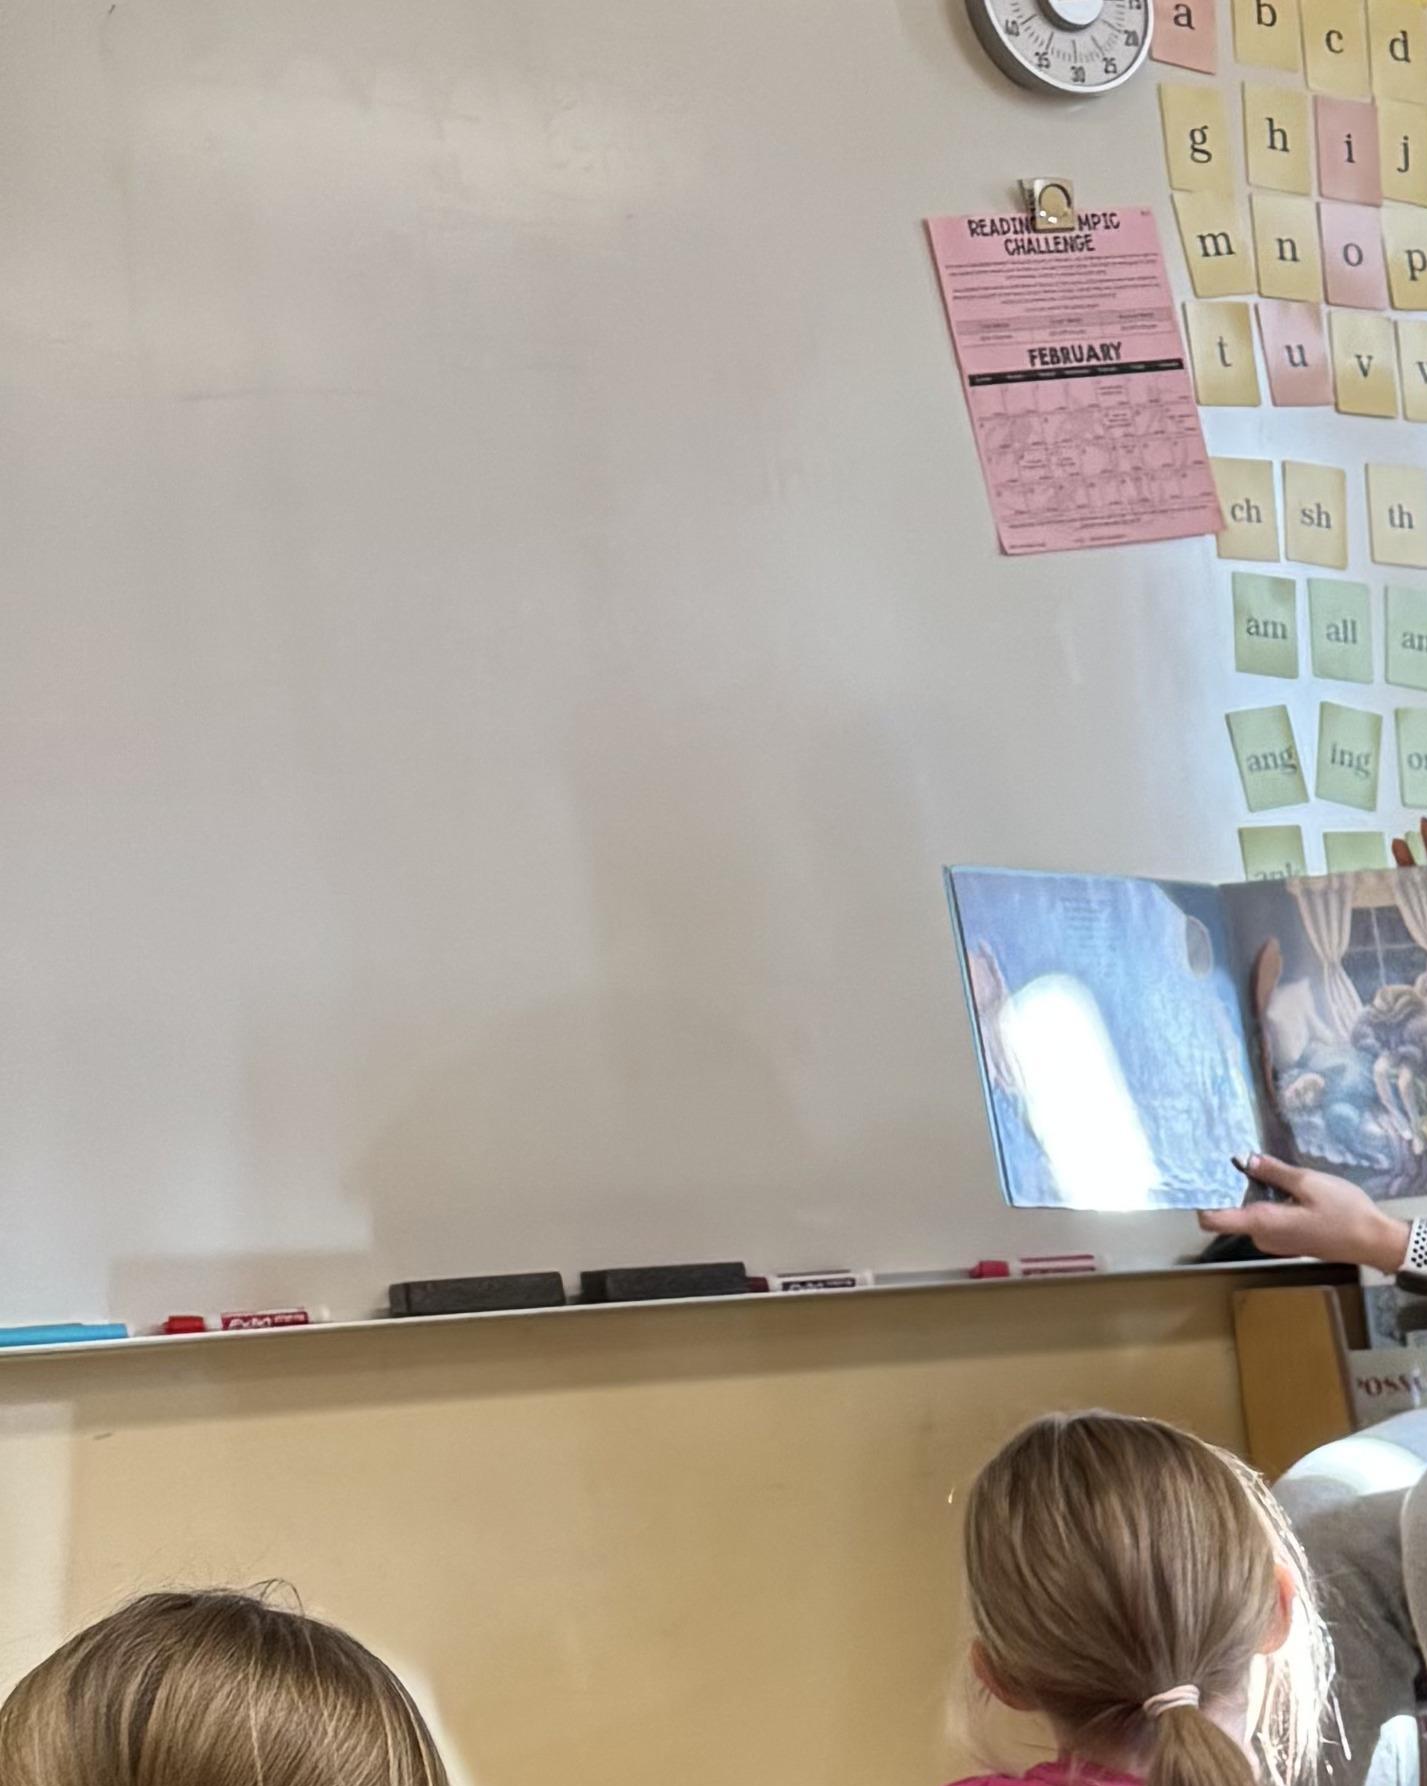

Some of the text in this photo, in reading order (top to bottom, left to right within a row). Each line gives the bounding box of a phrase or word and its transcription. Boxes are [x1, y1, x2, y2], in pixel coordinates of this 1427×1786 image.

[1173, 3, 1195, 30] a
[1255, 0, 1277, 27] b
[1325, 29, 1344, 54] c
[1389, 29, 1411, 64] d
[1070, 65, 1086, 83] 30
[1102, 57, 1118, 74] 25
[1189, 125, 1213, 164] g
[1265, 117, 1290, 153] h
[1345, 133, 1355, 164] i
[1396, 135, 1410, 173] j
[1004, 234, 1095, 255] CHALLENGE
[1197, 231, 1236, 258] m
[1276, 237, 1300, 263] n
[1342, 242, 1364, 267] o
[1405, 249, 1427, 282] p
[1027, 342, 1122, 368] FEBRUARY
[1217, 336, 1232, 368] t
[1284, 344, 1309, 368] u
[1354, 354, 1373, 378] v
[1230, 497, 1262, 524] ch
[1300, 502, 1332, 530] sh
[1388, 503, 1414, 530] th
[1245, 616, 1288, 640] am
[1326, 618, 1358, 645] all
[1246, 740, 1301, 775] ang
[1330, 743, 1371, 779] ing
